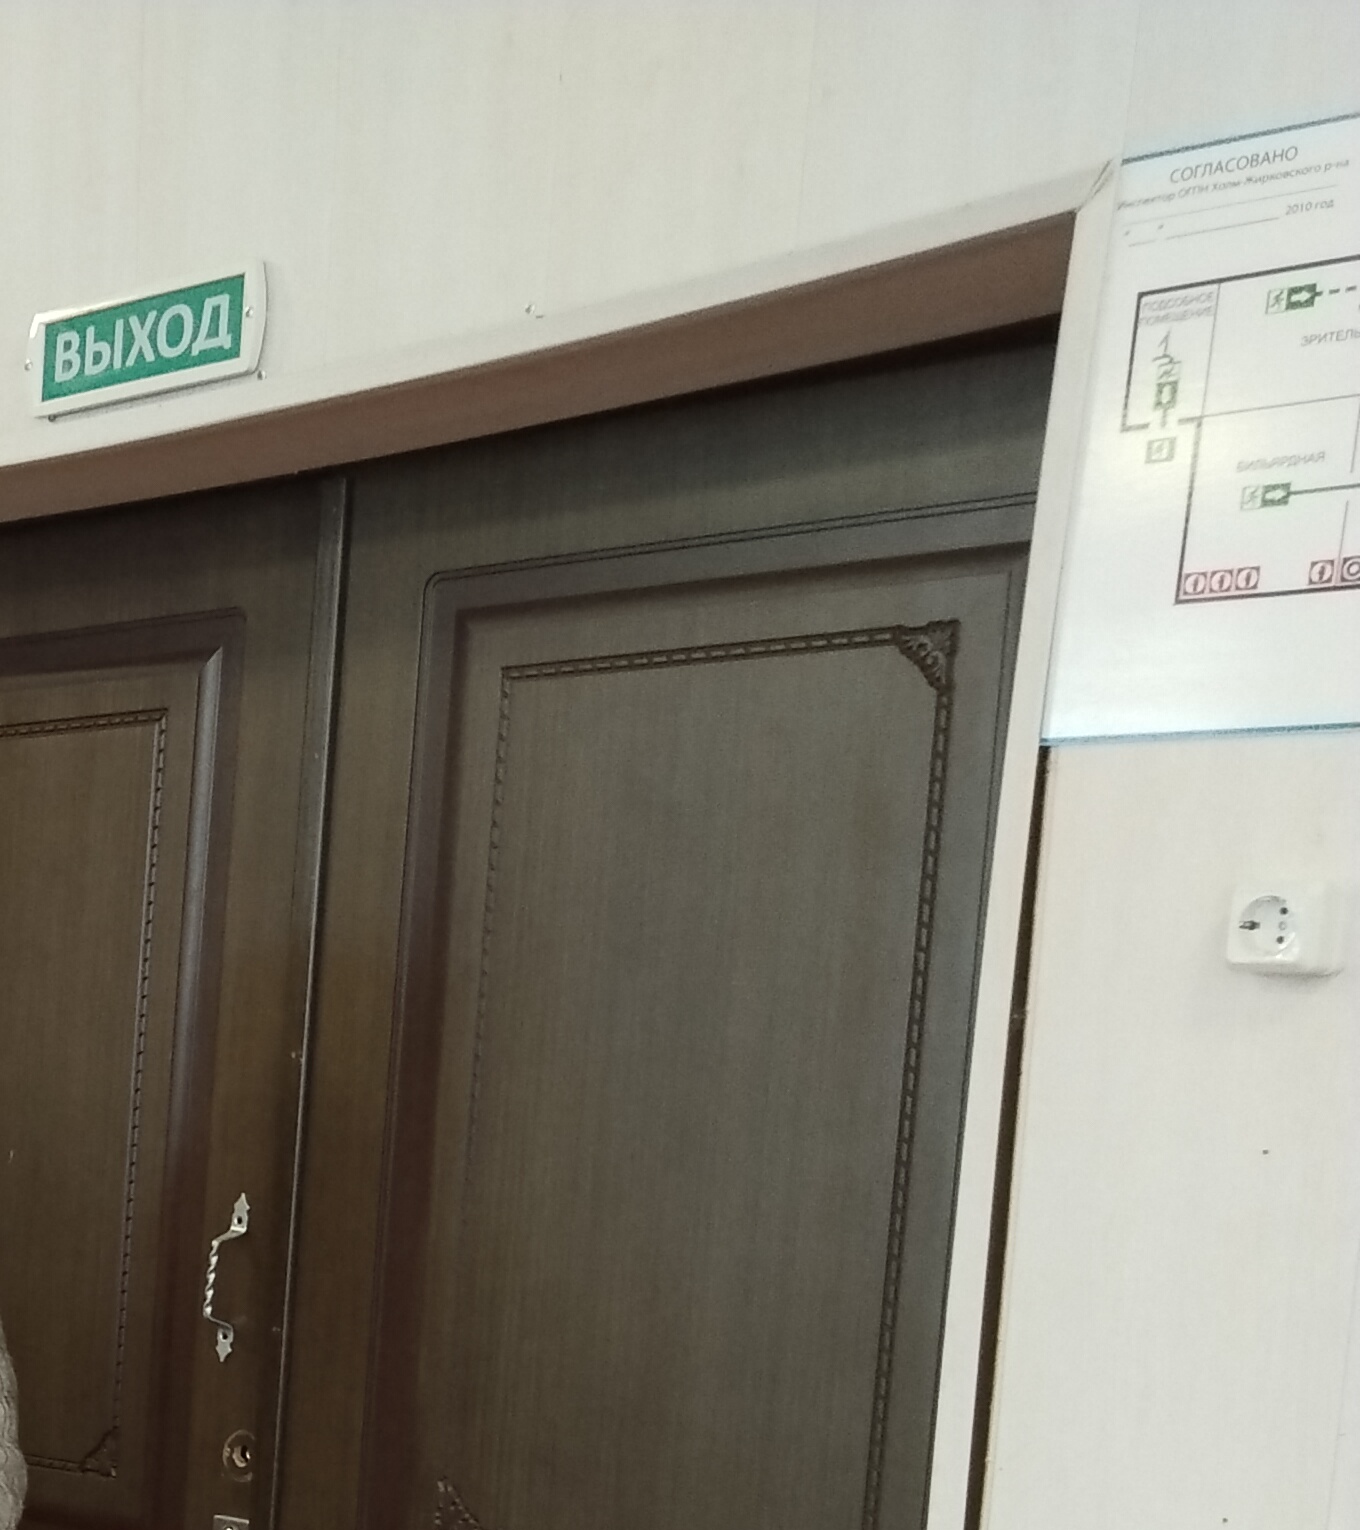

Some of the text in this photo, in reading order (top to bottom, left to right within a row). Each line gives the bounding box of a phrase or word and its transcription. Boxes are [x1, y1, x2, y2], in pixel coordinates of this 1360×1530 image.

[1170, 146, 1298, 184] СОГЛАСОВАНО
[1285, 199, 1335, 215] 2010 год
[54, 294, 232, 383] ВЫХОД
